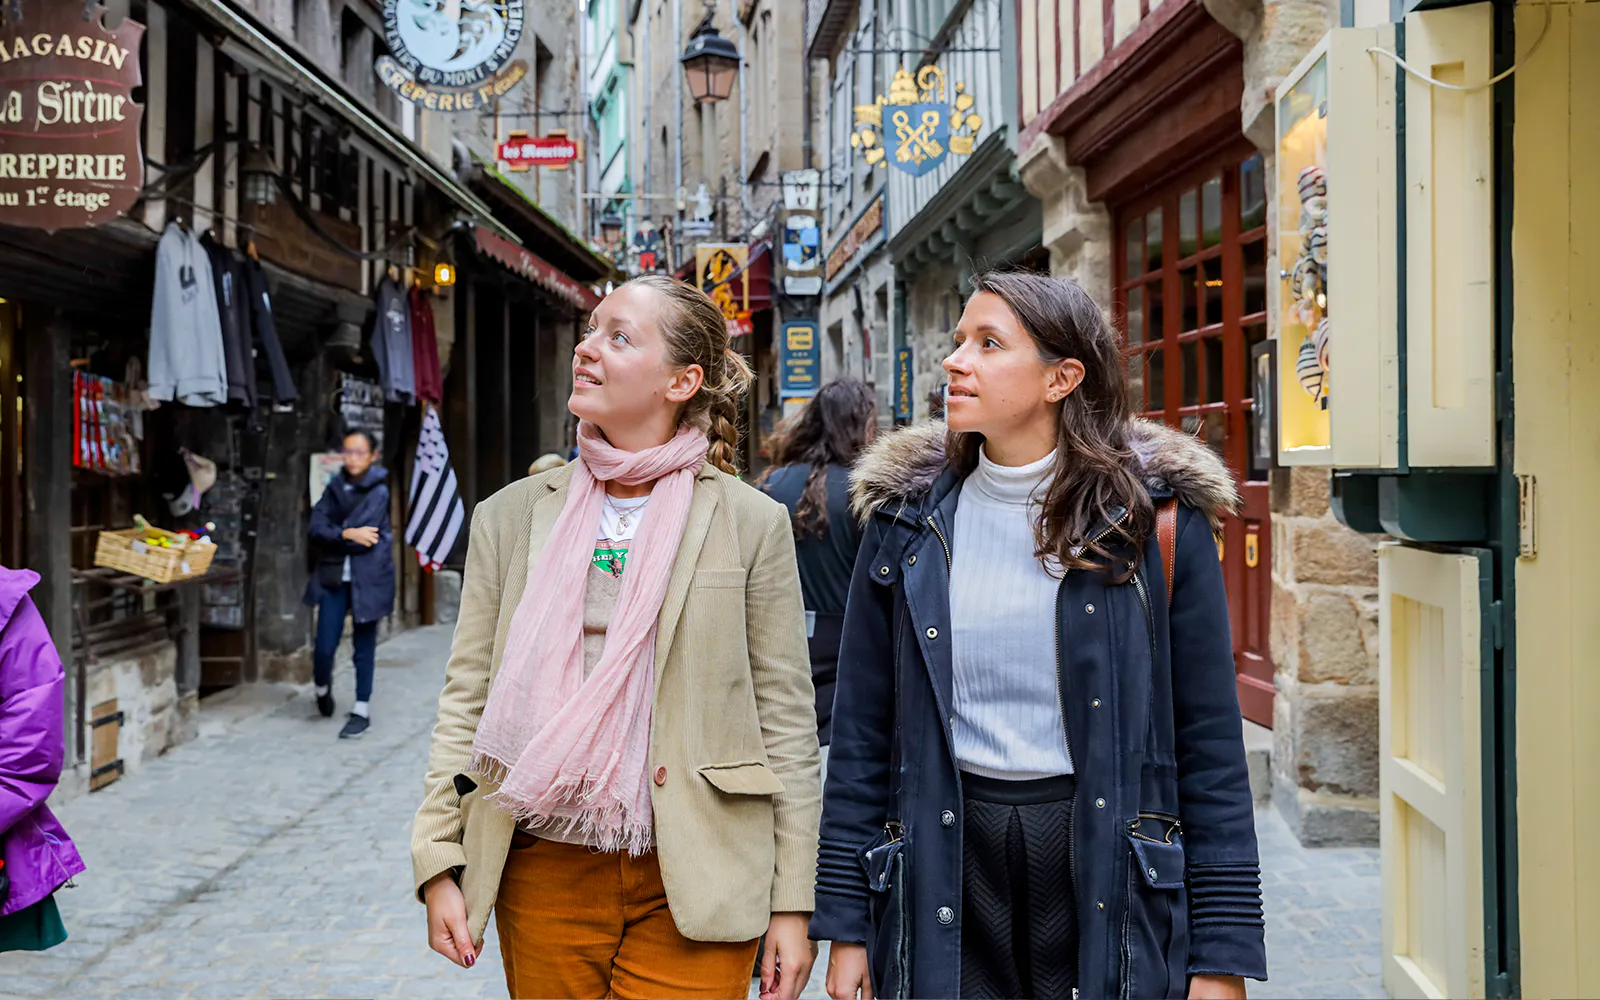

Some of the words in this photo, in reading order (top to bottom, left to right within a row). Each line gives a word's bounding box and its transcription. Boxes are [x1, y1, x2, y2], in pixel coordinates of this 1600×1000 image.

[443, 66, 485, 86] MONT
[33, 80, 126, 132] Sirène
[0, 153, 126, 180] REPERIE
[54, 188, 110, 212] étage
